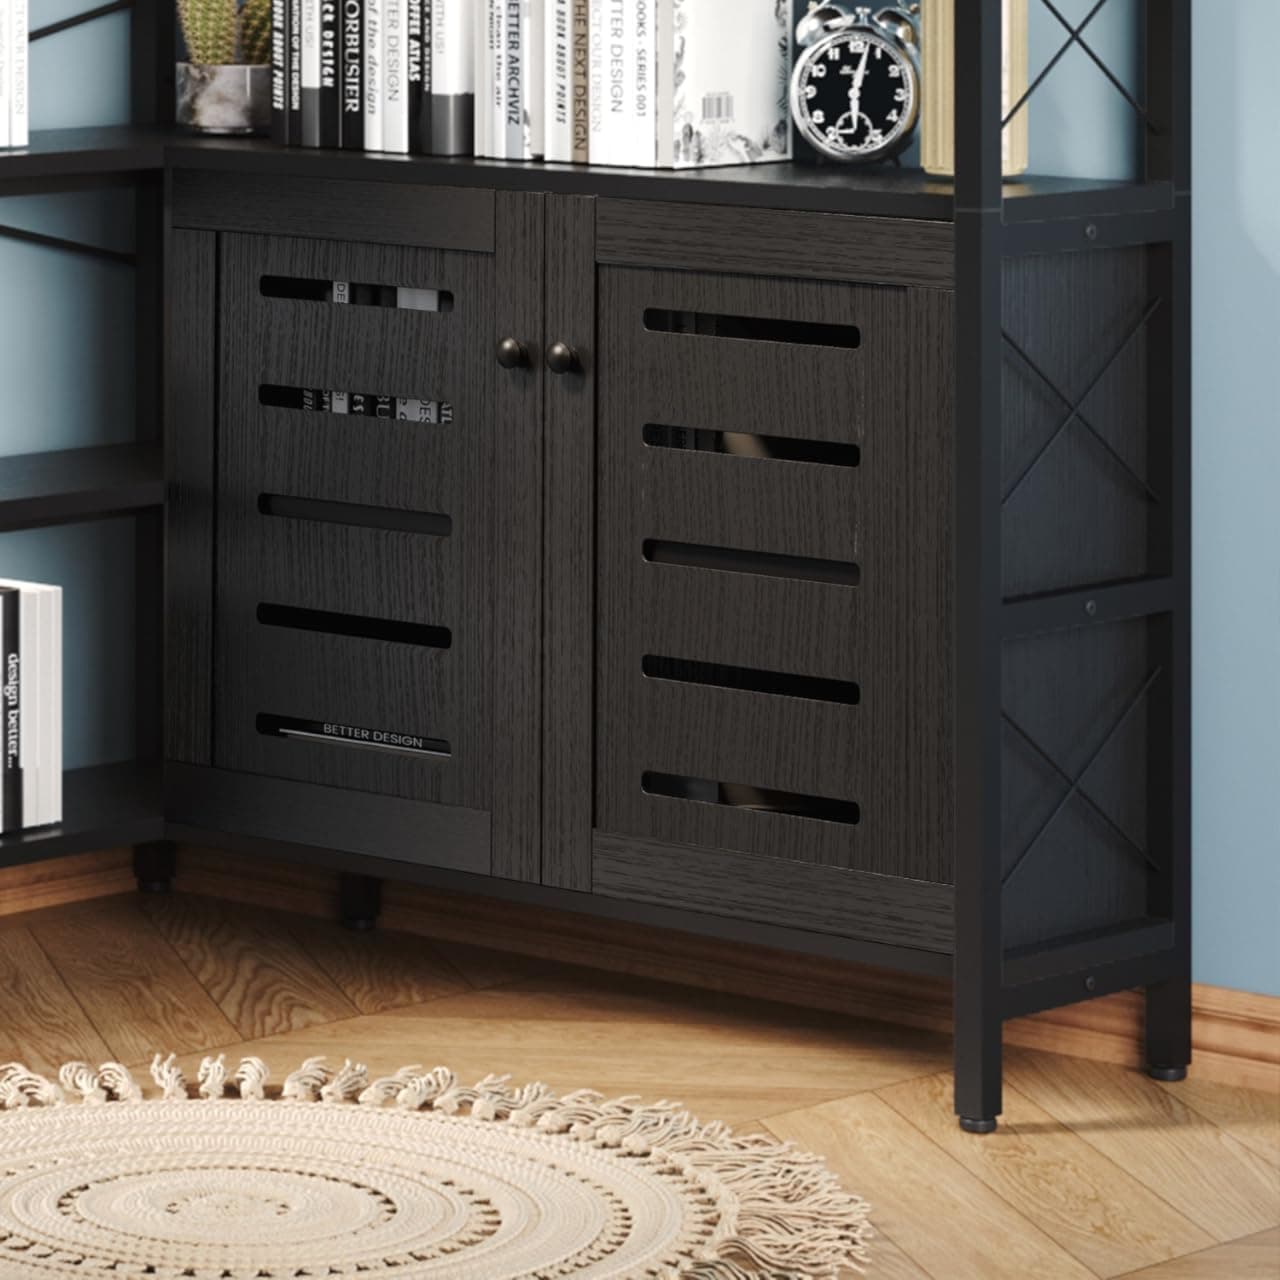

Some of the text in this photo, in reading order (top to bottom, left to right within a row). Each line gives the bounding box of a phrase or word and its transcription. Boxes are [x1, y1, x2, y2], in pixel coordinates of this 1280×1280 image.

[291, 36, 300, 50] OF
[368, 19, 378, 48] the
[592, 33, 602, 69] OUR
[850, 40, 864, 53] 12
[272, 0, 284, 110] BOOK ABOUT POINTS
[291, 52, 300, 71] THE
[322, 30, 335, 87] DESIGN
[387, 35, 400, 102] DESIGN
[408, 39, 420, 82] ATLAS
[575, 33, 586, 78] NEXT
[636, 48, 647, 92] SERIES
[812, 64, 827, 78] 10
[828, 47, 840, 60] 11
[875, 47, 882, 59] 1
[367, 54, 378, 115] design
[610, 44, 623, 113] DESIGN
[888, 65, 900, 78] 2
[291, 72, 300, 110] DESIGN
[507, 54, 520, 126] ARCHVIZ
[556, 83, 566, 125] POINTS
[592, 74, 602, 133] DESIGN
[636, 94, 647, 118] 001
[805, 85, 817, 99] 9
[894, 88, 906, 102] 3
[575, 84, 586, 151] DESIGN
[812, 110, 825, 123] 8
[886, 109, 898, 121] 4
[4, 653, 19, 706] design
[323, 722, 423, 748] BETTER DESIGN
